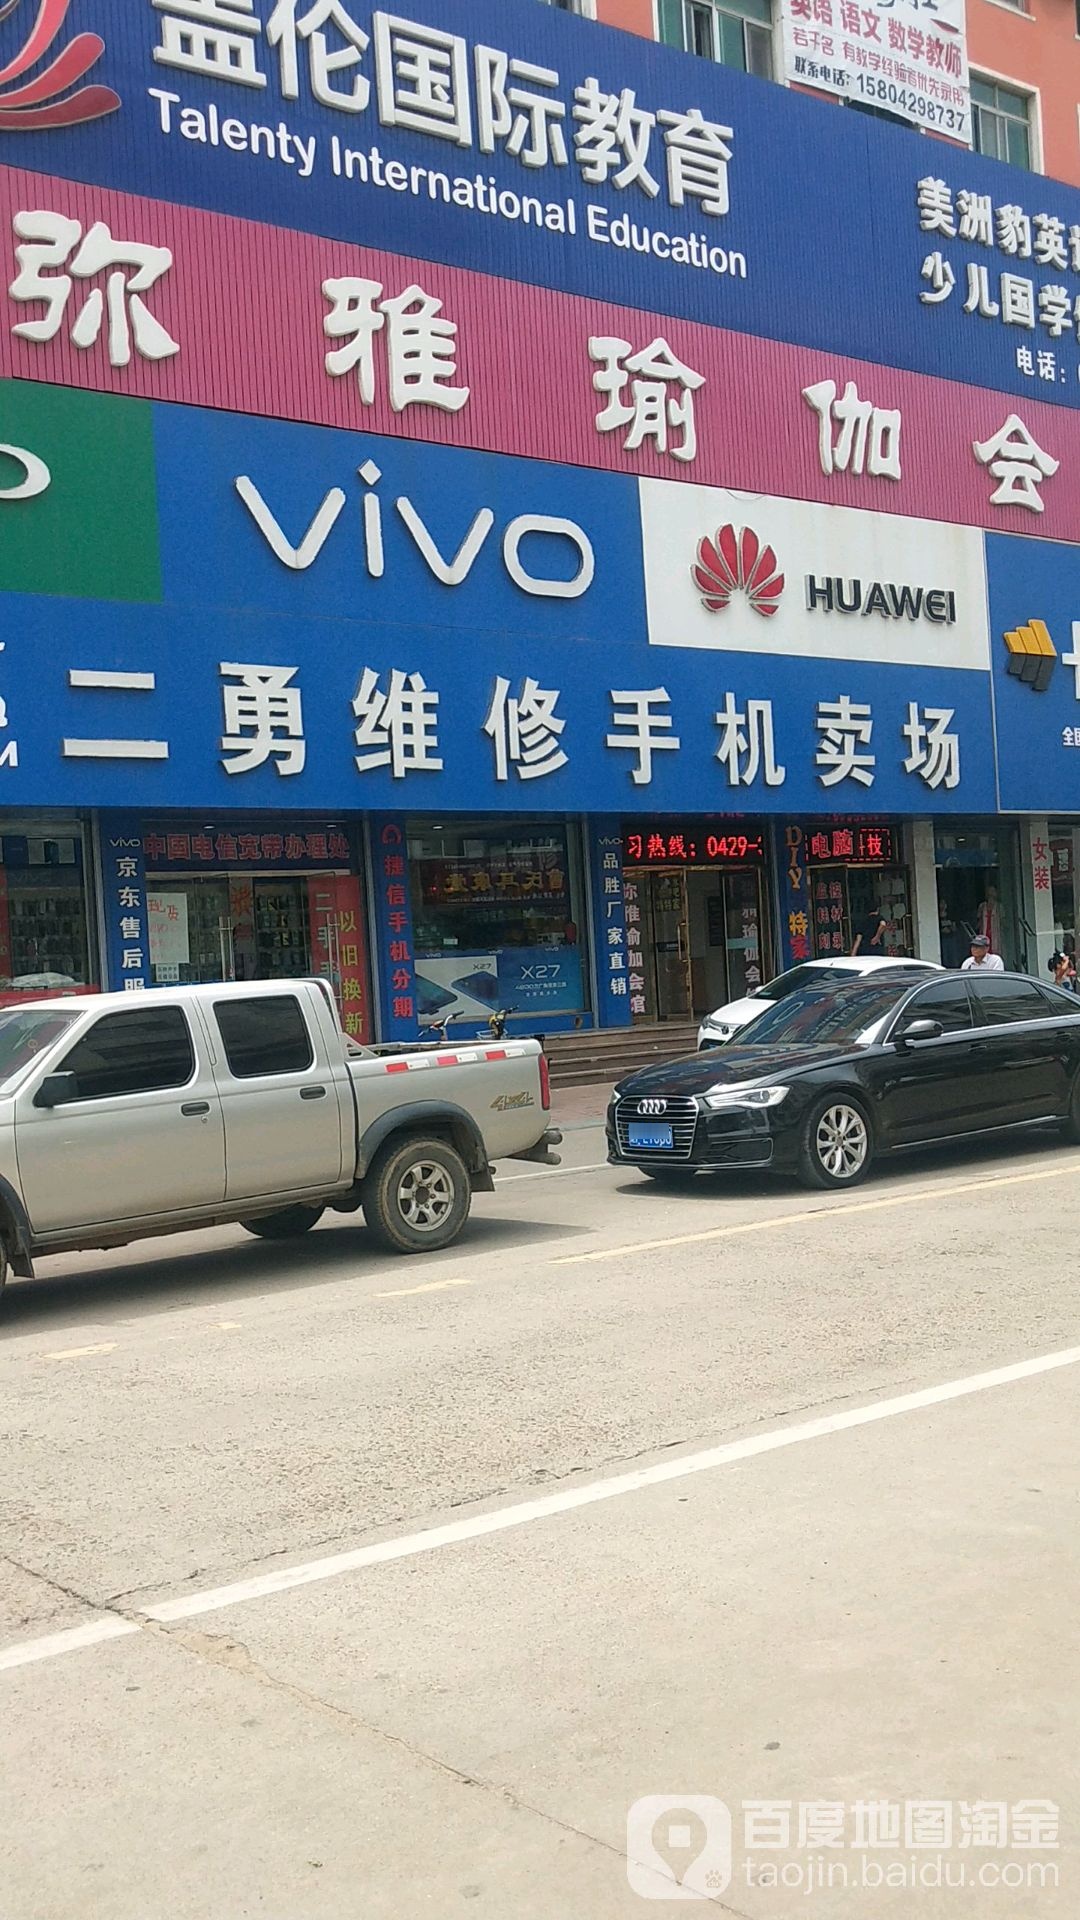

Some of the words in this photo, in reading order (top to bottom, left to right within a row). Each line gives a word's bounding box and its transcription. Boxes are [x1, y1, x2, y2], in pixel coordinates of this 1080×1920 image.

[792, 26, 834, 57] 若干名
[840, 2, 882, 43] 语文
[888, 17, 963, 79] 数学教师
[153, 0, 735, 217] 盖伦国际教育
[856, 73, 965, 132] 15804298737
[148, 88, 316, 177] Talenty
[331, 135, 576, 235] International
[588, 204, 748, 279] Education
[919, 251, 1080, 345] 少儿国学
[235, 458, 594, 598] vivo
[805, 574, 957, 624] HUAWEI
[110, 837, 141, 848] vivo
[143, 832, 349, 861] 中国电信宽带办理处
[1032, 837, 1050, 890] 女装
[383, 855, 413, 1018] 捷信手机分期
[603, 852, 627, 996] 品胜厂家直销
[339, 909, 363, 1035] 以旧换新
[521, 964, 560, 979] X27
